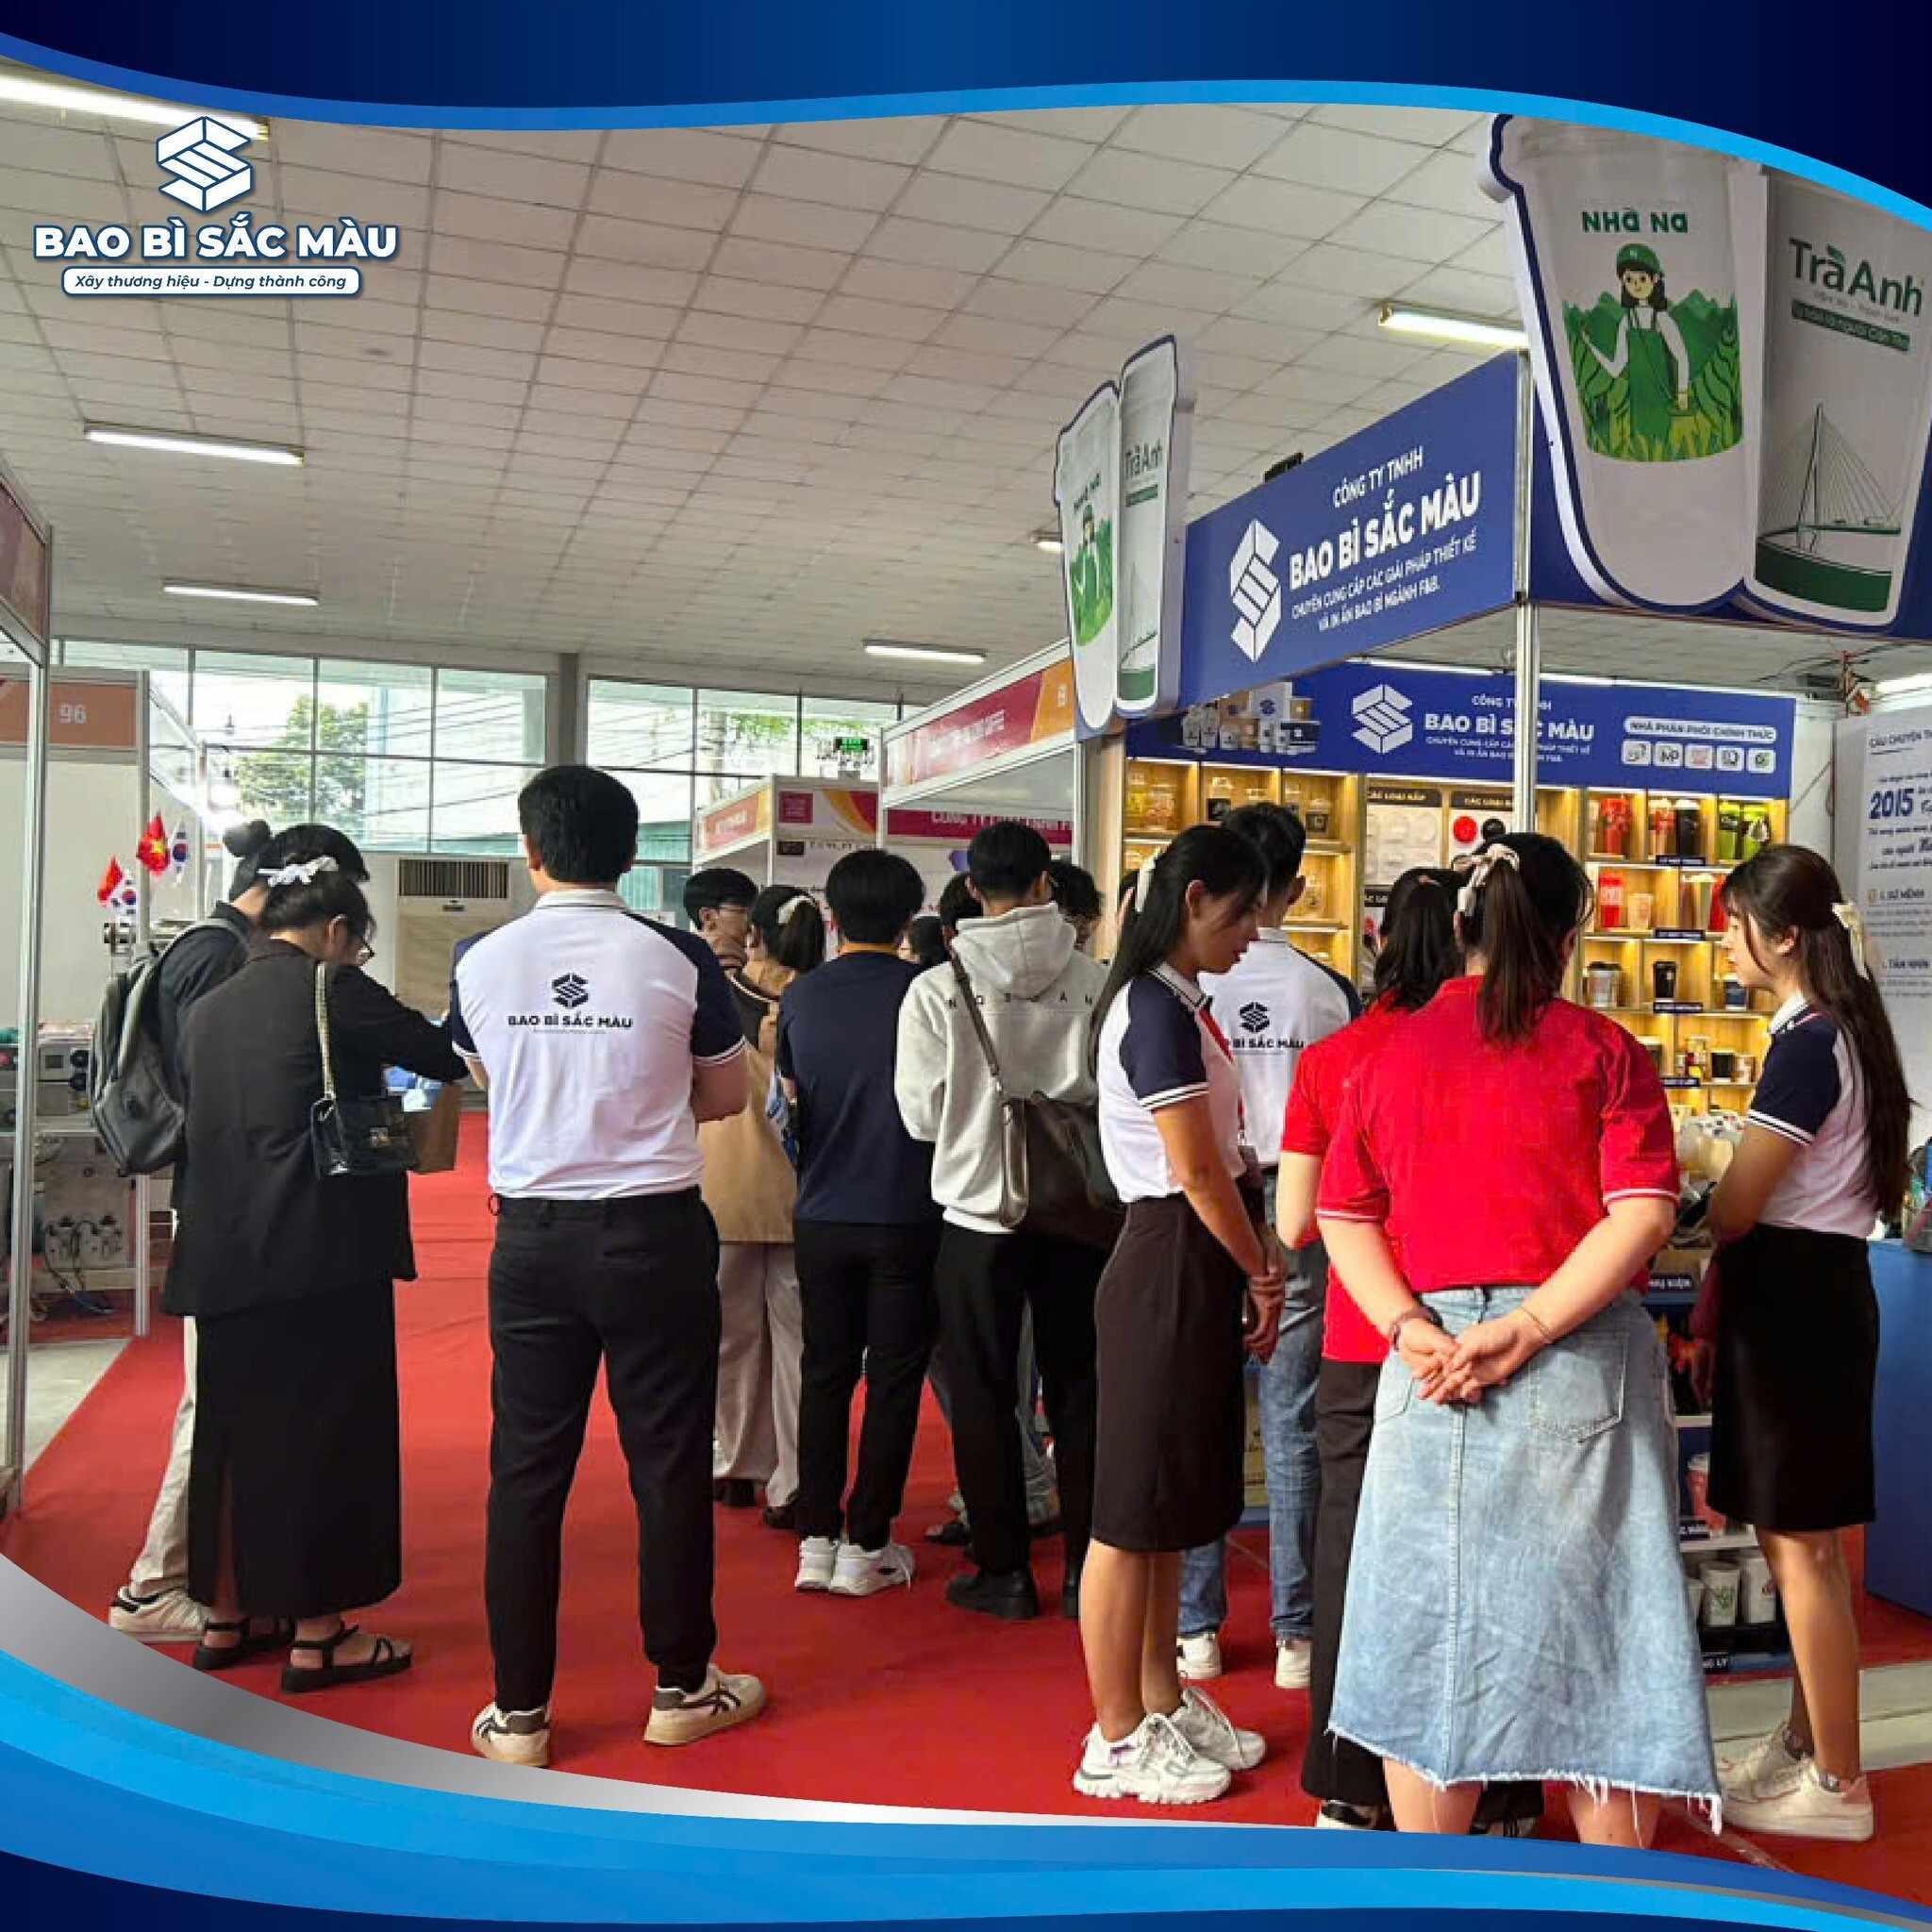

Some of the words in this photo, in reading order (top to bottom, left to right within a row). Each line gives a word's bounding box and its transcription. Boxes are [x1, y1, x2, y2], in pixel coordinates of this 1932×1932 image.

[1333, 475, 1365, 508] CÔNG
[1369, 465, 1384, 490] TY
[1387, 445, 1423, 482] TNHH
[1290, 541, 1333, 591] BAO
[1339, 516, 1360, 570] BÌ
[1364, 489, 1415, 558] SẮC
[1421, 471, 1482, 535] MÀU
[59, 704, 87, 724] 96
[1471, 693, 1504, 708] CÔNG
[1424, 713, 1472, 733] BAO
[1475, 713, 1497, 735] BÌ
[1548, 718, 1595, 741] MÀU
[1869, 787, 1914, 820] 2015
[508, 1015, 541, 1026] BAO
[544, 1013, 559, 1026] BÌ
[562, 1010, 594, 1026] SẮC
